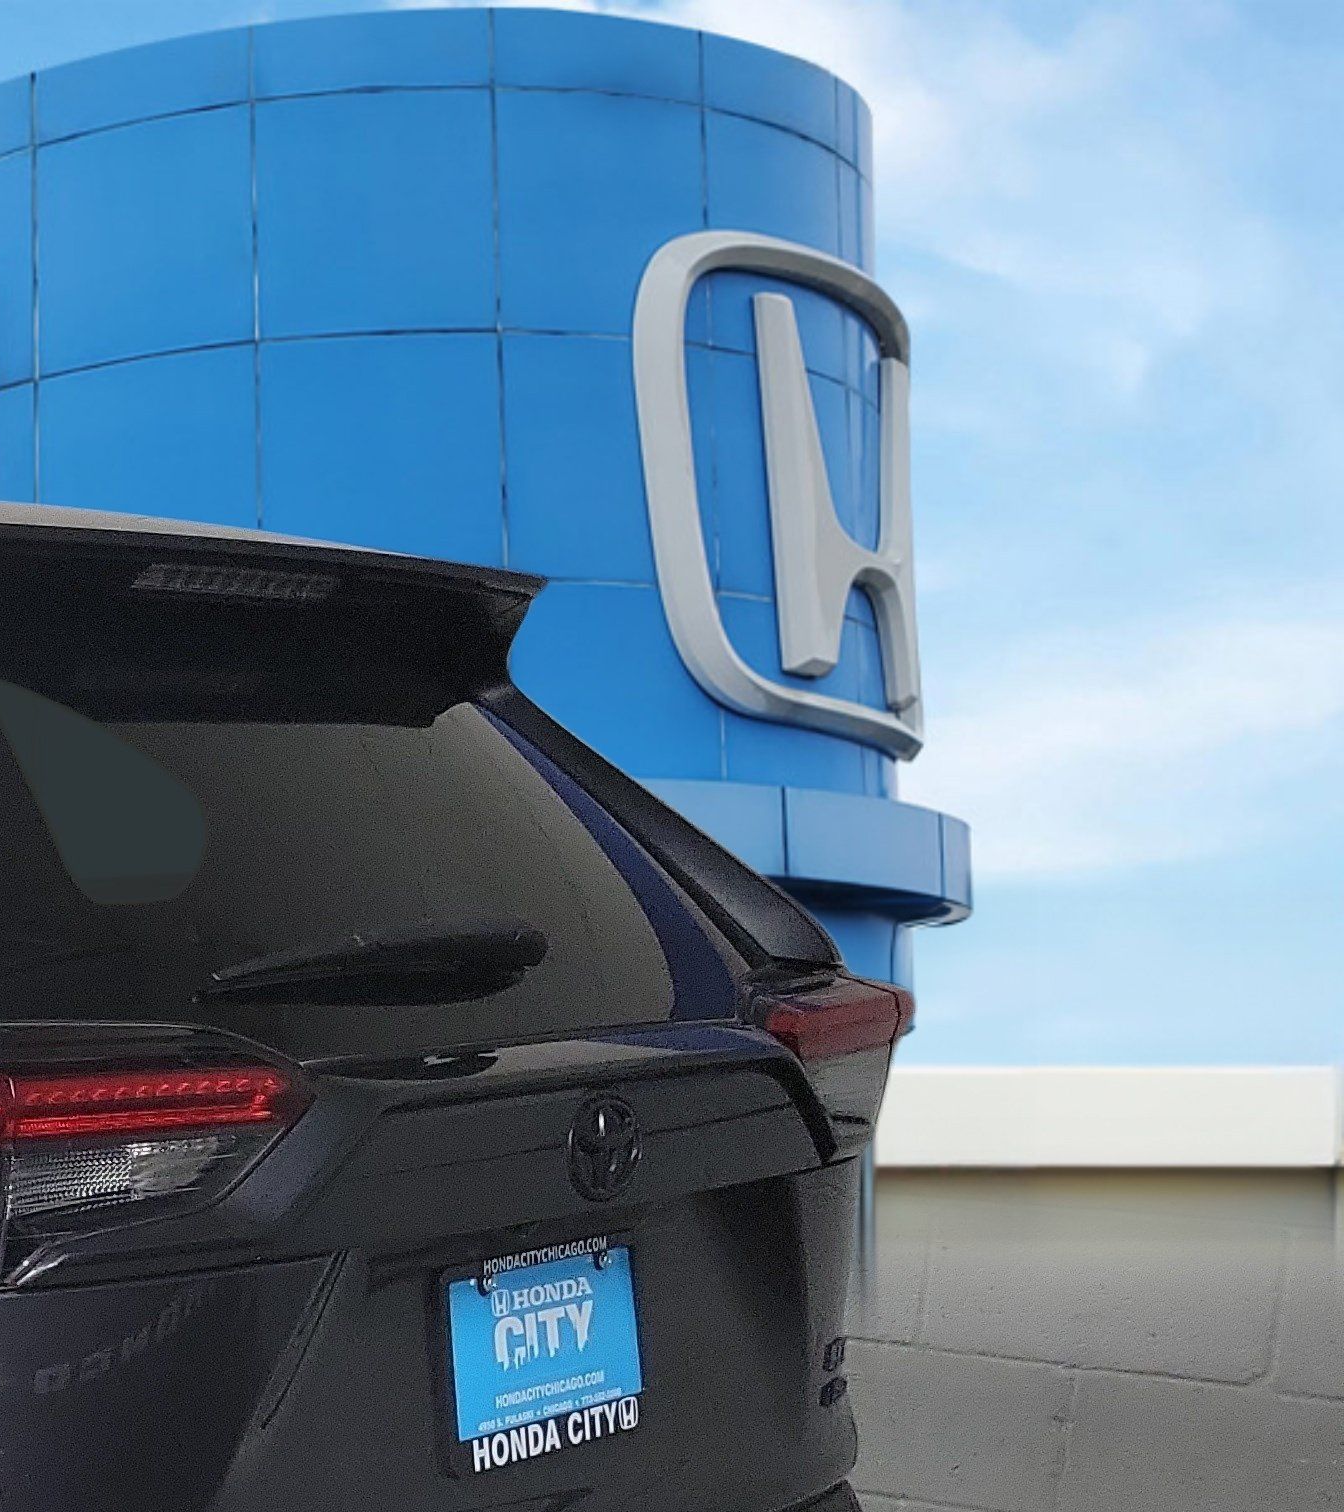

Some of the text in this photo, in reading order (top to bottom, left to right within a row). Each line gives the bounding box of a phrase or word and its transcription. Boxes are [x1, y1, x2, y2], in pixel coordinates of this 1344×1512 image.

[482, 1235, 608, 1276] HONDACITYCHICAGO.COM
[512, 1276, 594, 1311] HONDA
[493, 1299, 594, 1373] CITY
[495, 1370, 605, 1410] HONDACITYCHICAGO.COM
[472, 1419, 562, 1473] HONDA
[567, 1401, 618, 1445] CITY
